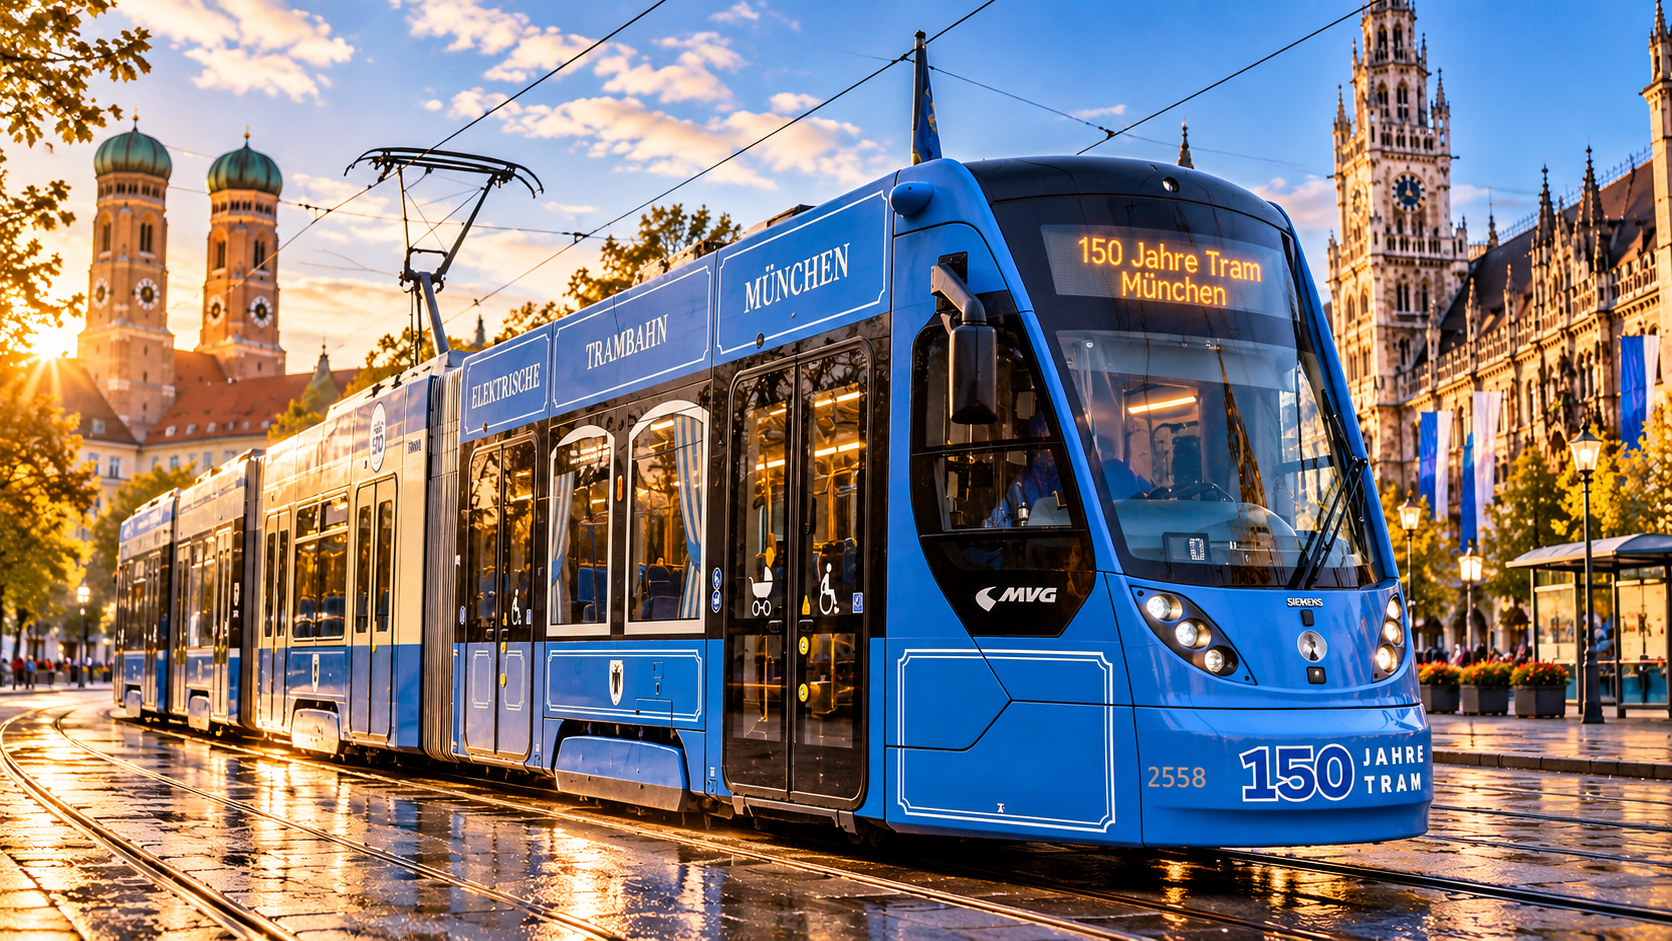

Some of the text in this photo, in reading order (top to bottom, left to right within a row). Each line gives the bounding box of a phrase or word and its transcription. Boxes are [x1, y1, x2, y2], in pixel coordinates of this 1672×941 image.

[744, 243, 850, 313] MÜNCHEN
[1078, 236, 1262, 282] 150 Jahre Tram
[1121, 271, 1226, 306] München
[586, 314, 669, 370] TRAMBAHN
[471, 363, 540, 410] ELEKTRISCHE
[998, 586, 1057, 603] MVG
[1239, 743, 1355, 802] 150
[1363, 745, 1424, 766] JAHRE
[1148, 766, 1206, 788] 2558
[1364, 773, 1421, 794] TRAM
